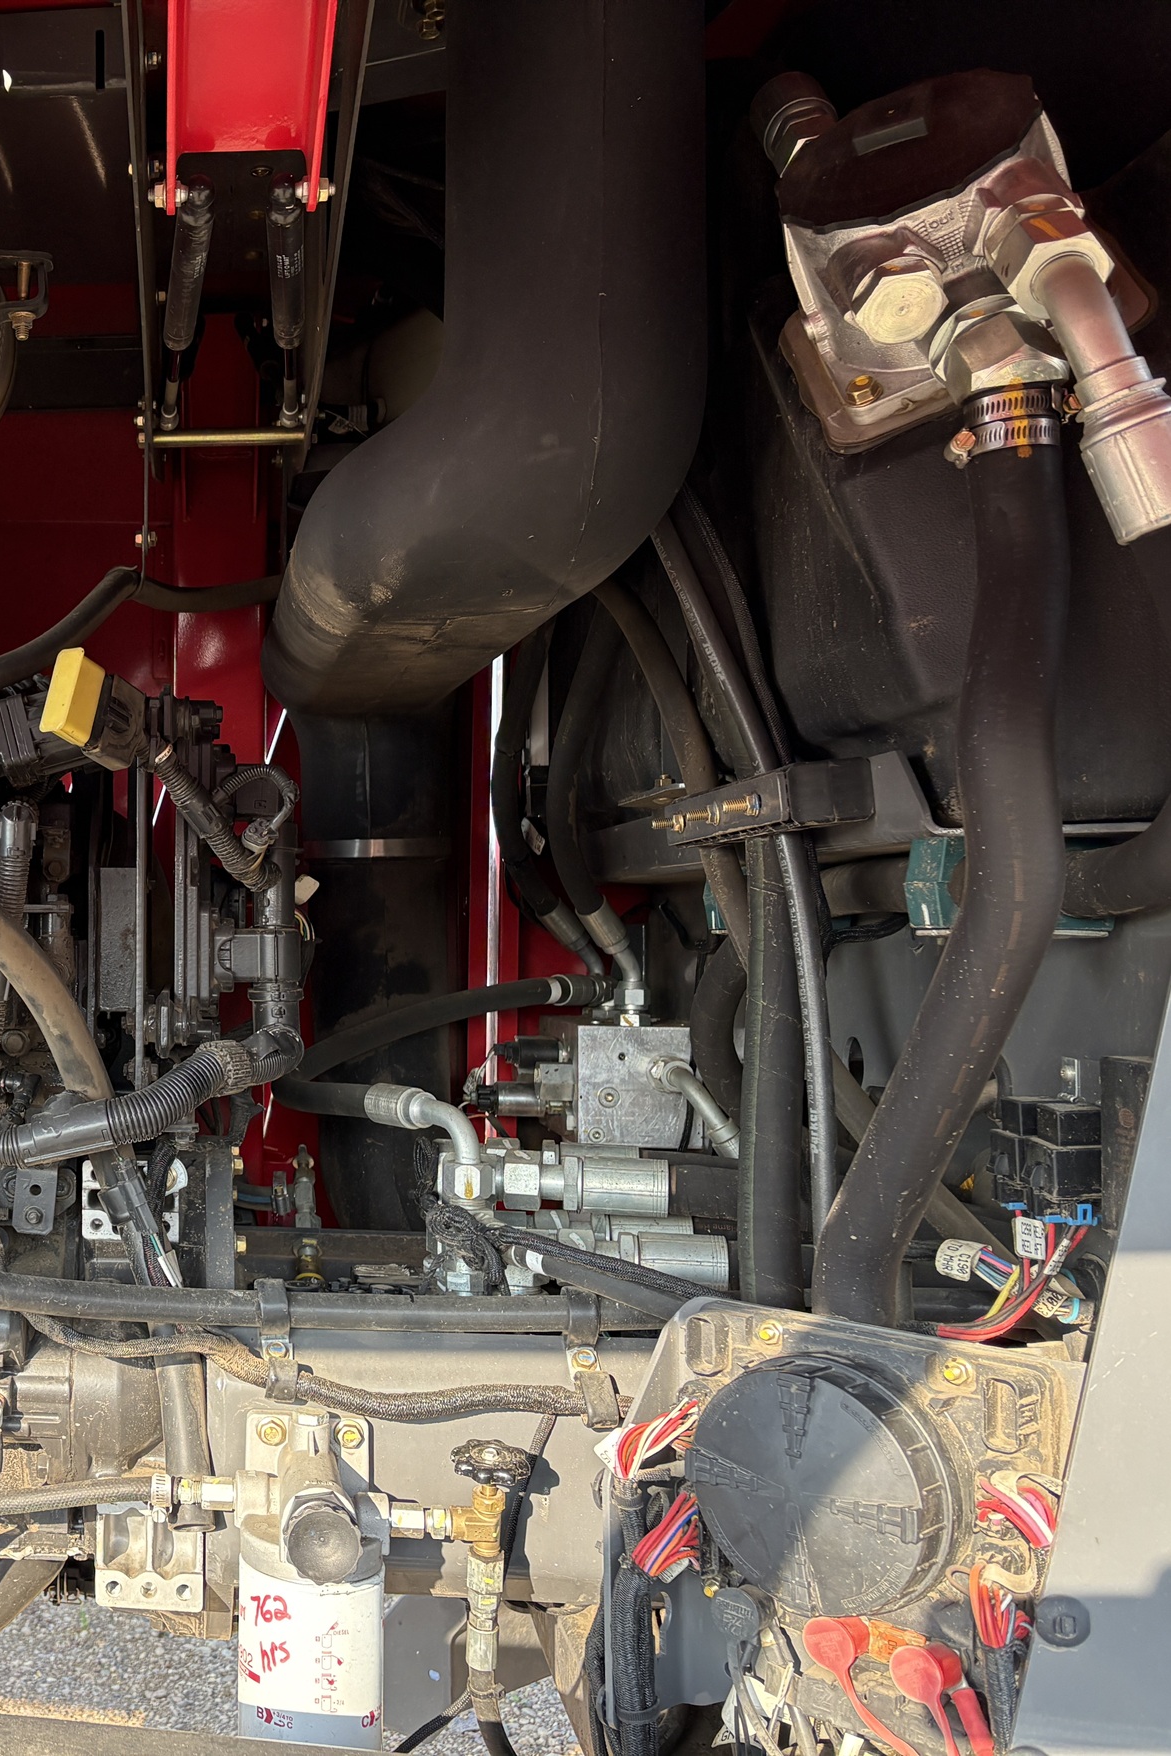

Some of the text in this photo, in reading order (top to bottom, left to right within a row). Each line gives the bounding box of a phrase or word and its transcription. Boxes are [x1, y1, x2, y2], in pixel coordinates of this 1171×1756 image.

[810, 1108, 820, 1165] Parker
[947, 1243, 964, 1251] TO
[250, 1594, 292, 1627] 762
[259, 1640, 291, 1674] hrs
[256, 1705, 265, 1720] B
[286, 1721, 293, 1730] C
[361, 1715, 370, 1729] C
